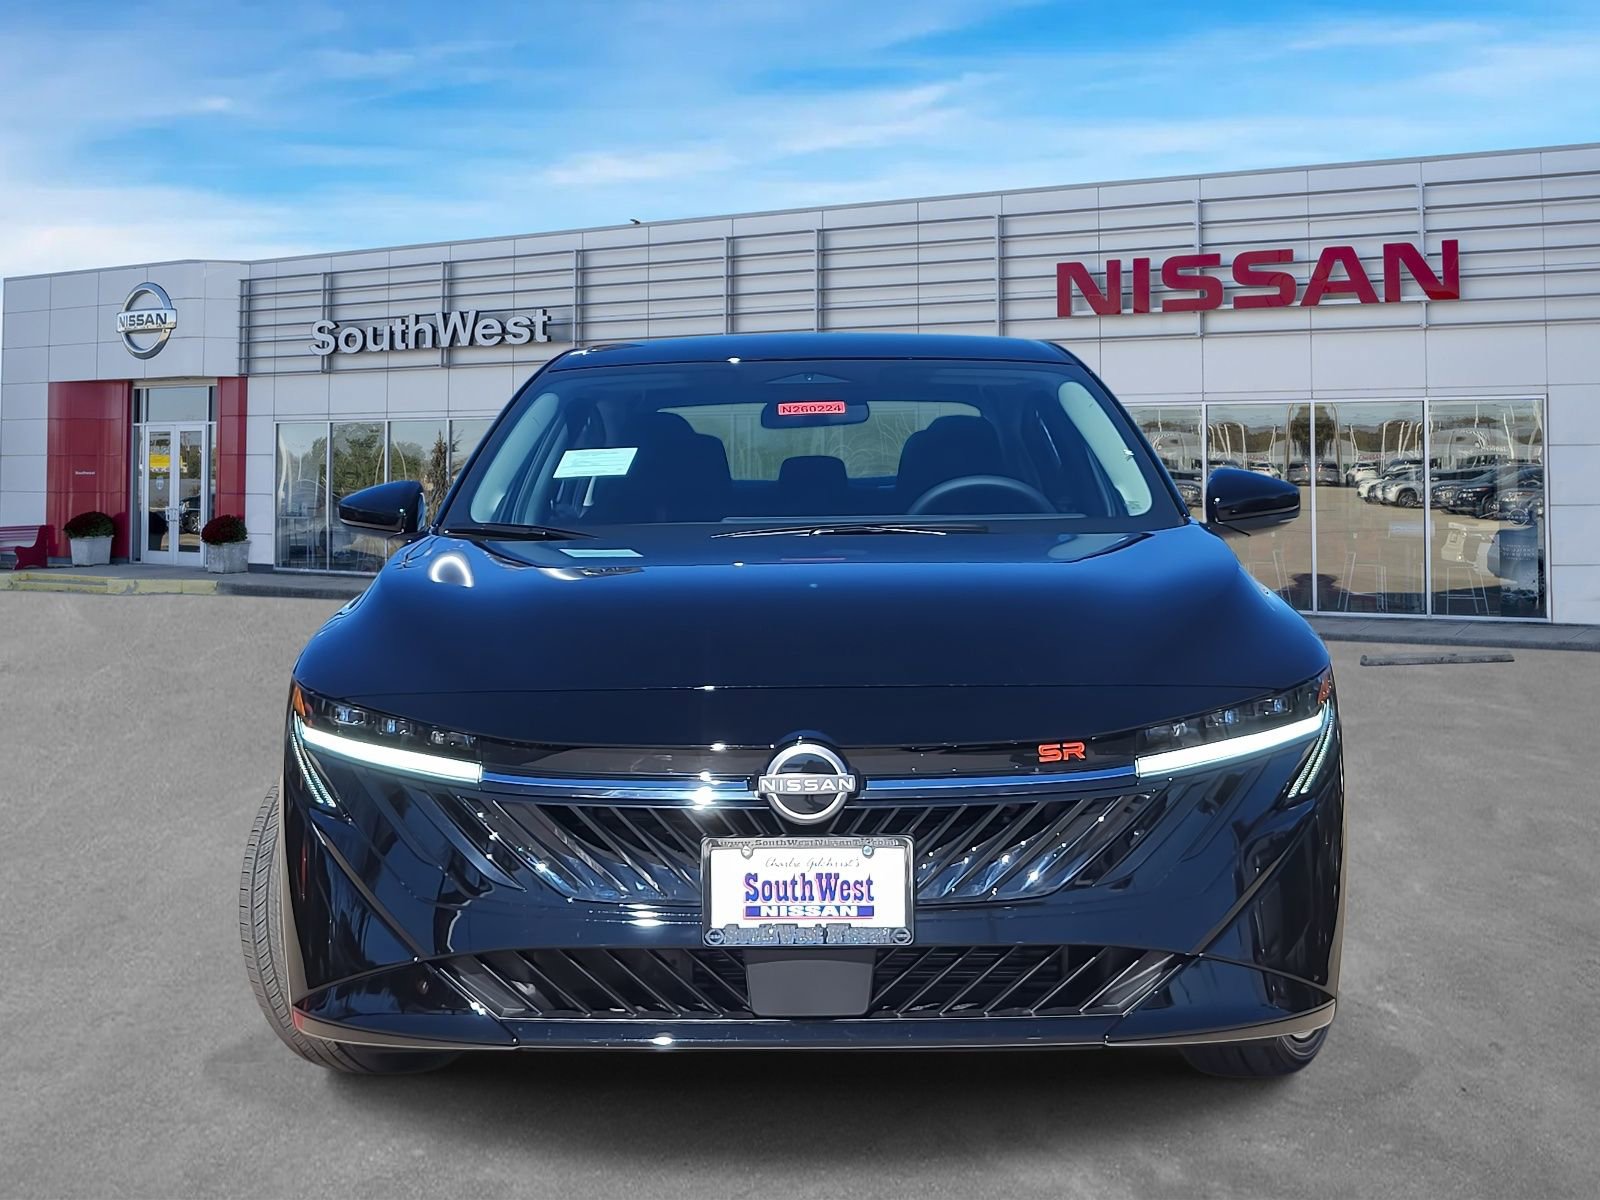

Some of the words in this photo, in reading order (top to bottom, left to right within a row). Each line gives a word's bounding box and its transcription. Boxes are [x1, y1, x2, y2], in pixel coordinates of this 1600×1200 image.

[1056, 239, 1461, 318] NISSAN
[119, 312, 168, 328] NISSAN
[309, 308, 552, 356] SouthWest
[782, 404, 842, 414] N260224
[1038, 741, 1086, 763] SR
[761, 777, 854, 792] NISSAN
[743, 872, 875, 903] SouthWest
[760, 905, 858, 917] NISSAN
